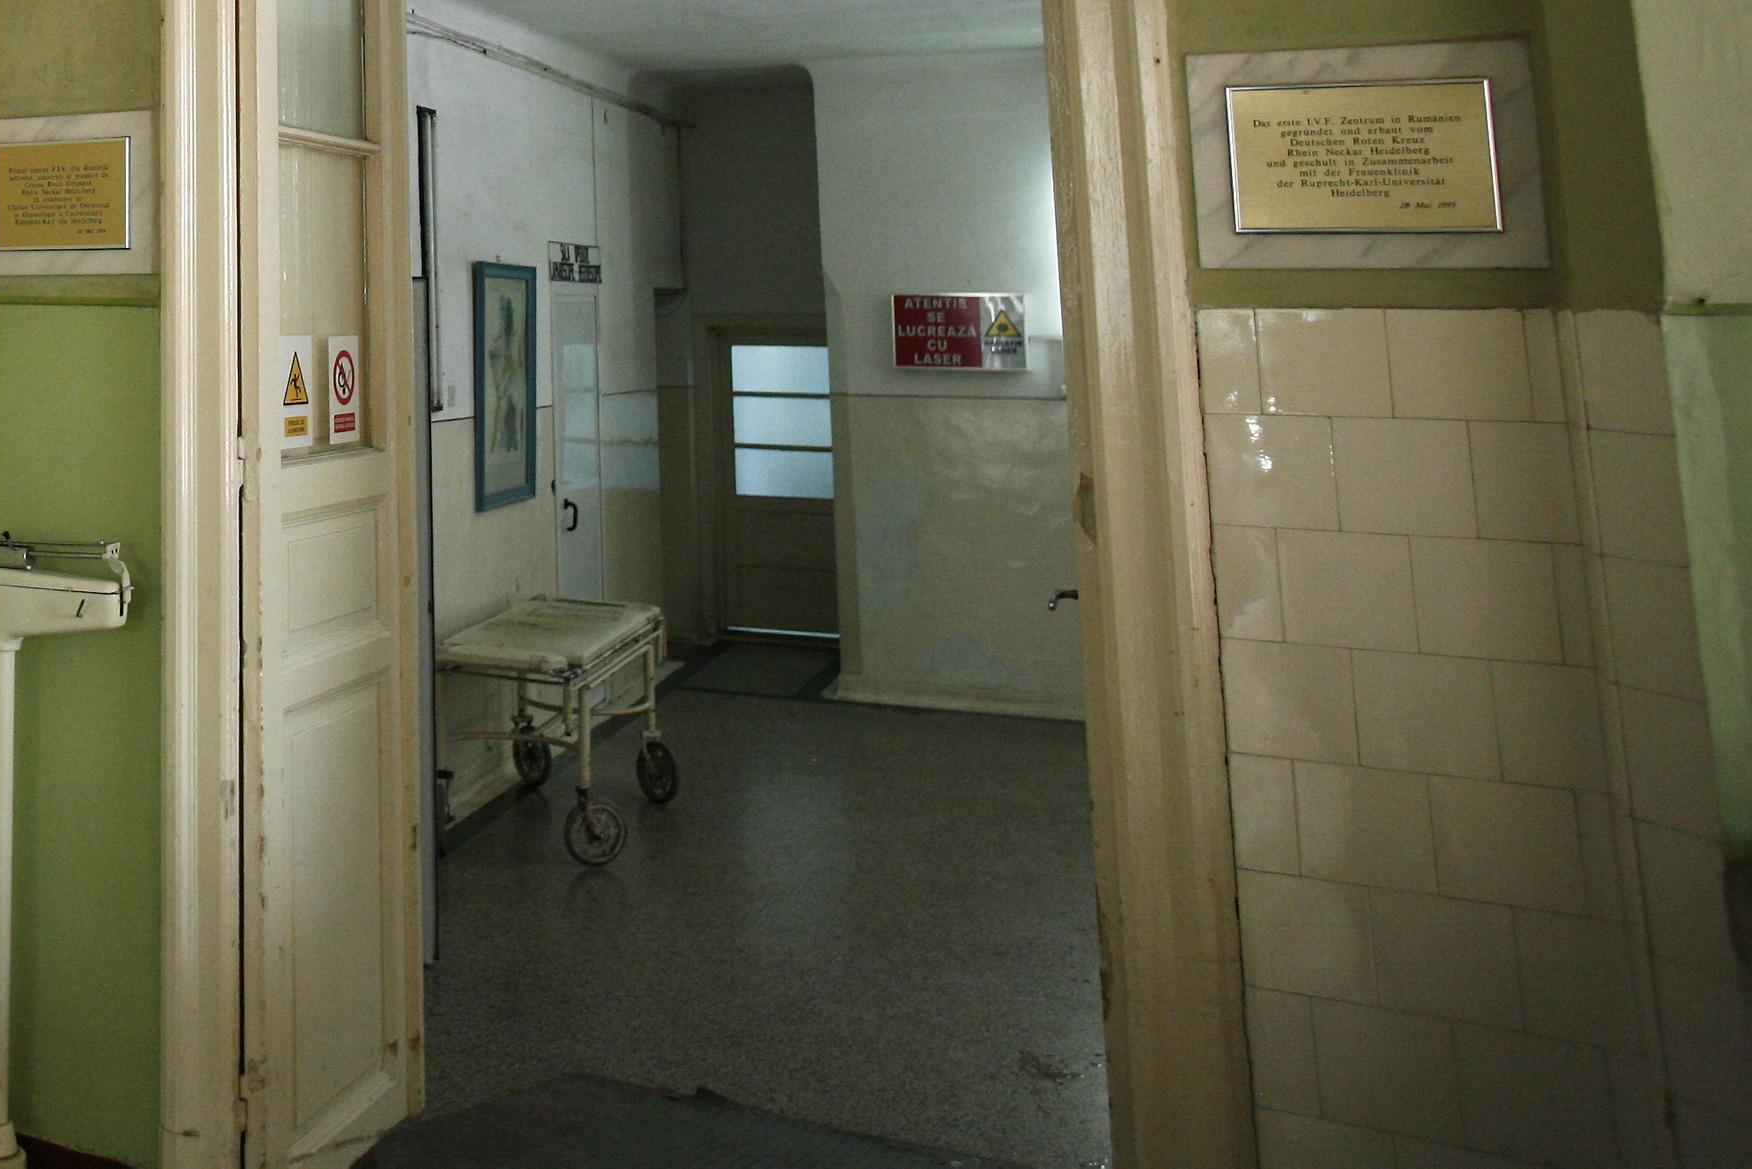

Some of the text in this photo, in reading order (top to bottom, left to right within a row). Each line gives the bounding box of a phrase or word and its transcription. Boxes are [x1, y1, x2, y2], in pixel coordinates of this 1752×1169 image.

[1253, 119, 1271, 128] Das
[1277, 119, 1301, 127] erste
[1340, 117, 1385, 126] Zentrum
[1391, 116, 1401, 124] in
[1340, 127, 1360, 136] und
[1368, 126, 1402, 135] erbaut
[1410, 126, 1434, 134] vom
[1290, 135, 1425, 147] Deutschen Roten Kreuz
[1287, 146, 1430, 157] Rhein Neckar Heidelberg
[1266, 159, 1286, 168] und
[1344, 158, 1355, 167] in
[1362, 156, 1454, 166] Zusammenarbeit
[1299, 167, 1421, 178] mit der Frauenklinik
[1277, 179, 1294, 188] der
[1331, 188, 1390, 199] Heidelberg
[927, 311, 946, 323] SE
[927, 339, 948, 352] CU
[914, 353, 963, 366] LASER
